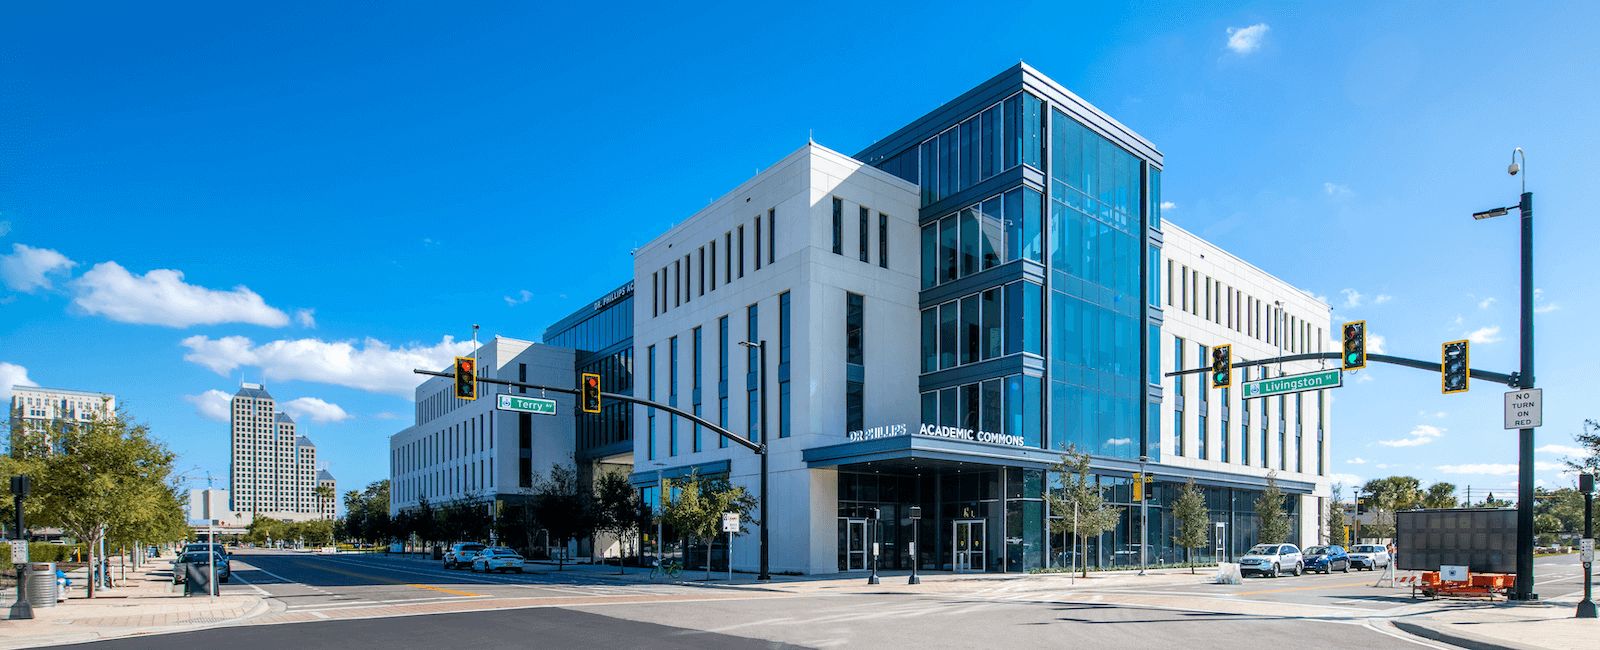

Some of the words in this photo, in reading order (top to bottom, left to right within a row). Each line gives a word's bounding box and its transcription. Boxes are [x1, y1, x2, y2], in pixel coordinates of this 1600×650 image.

[1265, 376, 1322, 392] Livingston
[517, 400, 543, 411] Terry
[1512, 401, 1535, 409] TURN
[865, 423, 907, 441] PHILLIPS
[919, 423, 974, 440] ACADEMIC
[977, 431, 1024, 447] COMMONS
